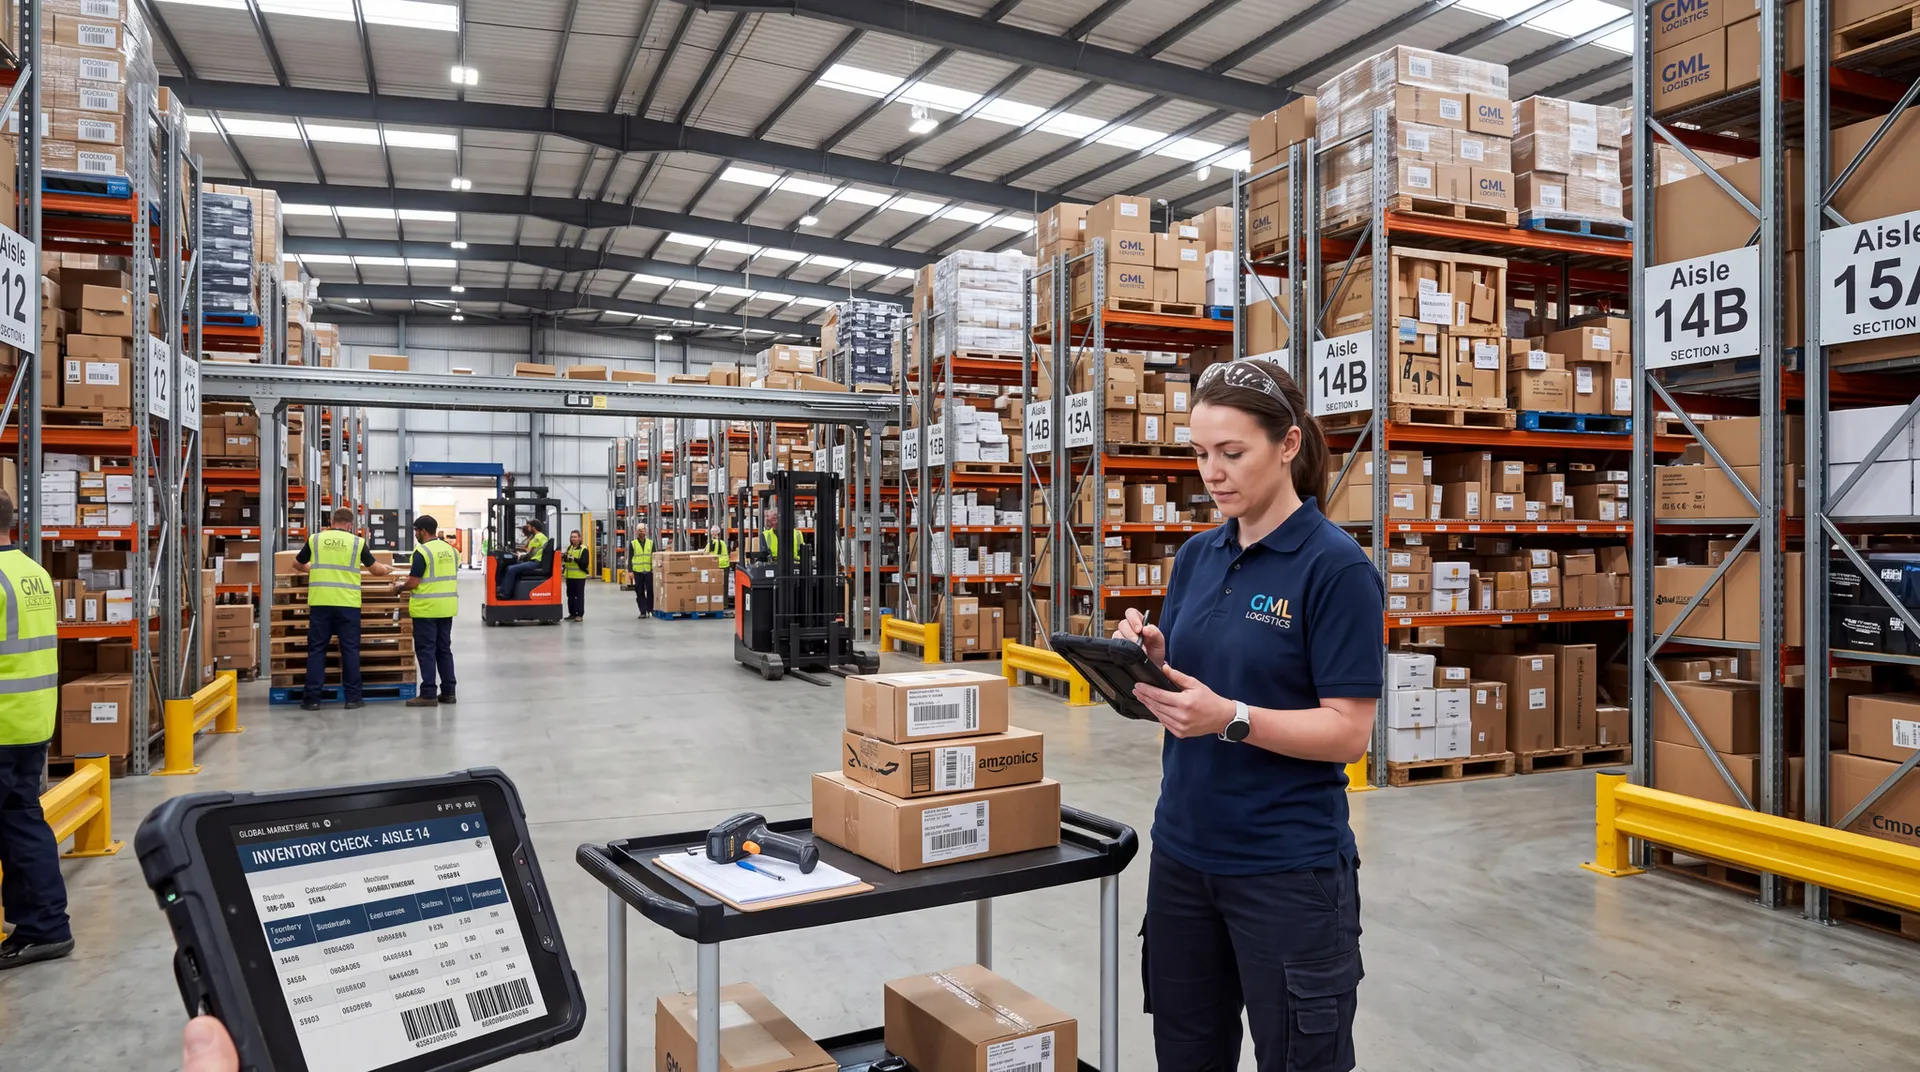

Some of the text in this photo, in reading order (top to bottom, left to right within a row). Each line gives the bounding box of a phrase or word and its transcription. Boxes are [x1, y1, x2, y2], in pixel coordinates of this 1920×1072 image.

[1661, 9, 1709, 34] LOGISTICS
[1662, 52, 1710, 83] GML
[1662, 71, 1710, 95] LOGISTICS
[1478, 105, 1504, 120] GML
[1479, 178, 1506, 192] GML
[1252, 215, 1272, 229] GML
[0, 232, 26, 267] Aisle
[1119, 240, 1145, 251] GML
[1119, 273, 1145, 284] GML
[1670, 261, 1730, 290] Aisle
[2, 267, 26, 324] 12
[1655, 287, 1748, 343] 14B
[1853, 316, 1916, 336] SECTION
[1326, 340, 1358, 359] Aisle
[1670, 344, 1730, 361] SECTION 3
[154, 366, 166, 401] 12
[1319, 360, 1367, 398] 14B
[185, 381, 196, 413] 13
[1071, 396, 1088, 408] Aisle
[1325, 401, 1353, 411] SECTION
[1031, 405, 1046, 416] Aisle
[1029, 419, 1050, 441] 14B
[1068, 411, 1092, 434] 15A
[904, 443, 917, 459] 14B
[20, 577, 50, 595] GML
[1250, 594, 1292, 619] GML
[1245, 611, 1291, 629] LOGISTICS
[239, 828, 266, 839] GLOBAL
[252, 841, 327, 865] INVENTORY
[330, 835, 372, 853] CHECK
[382, 829, 414, 846] AISLE
[415, 826, 431, 840] 14
